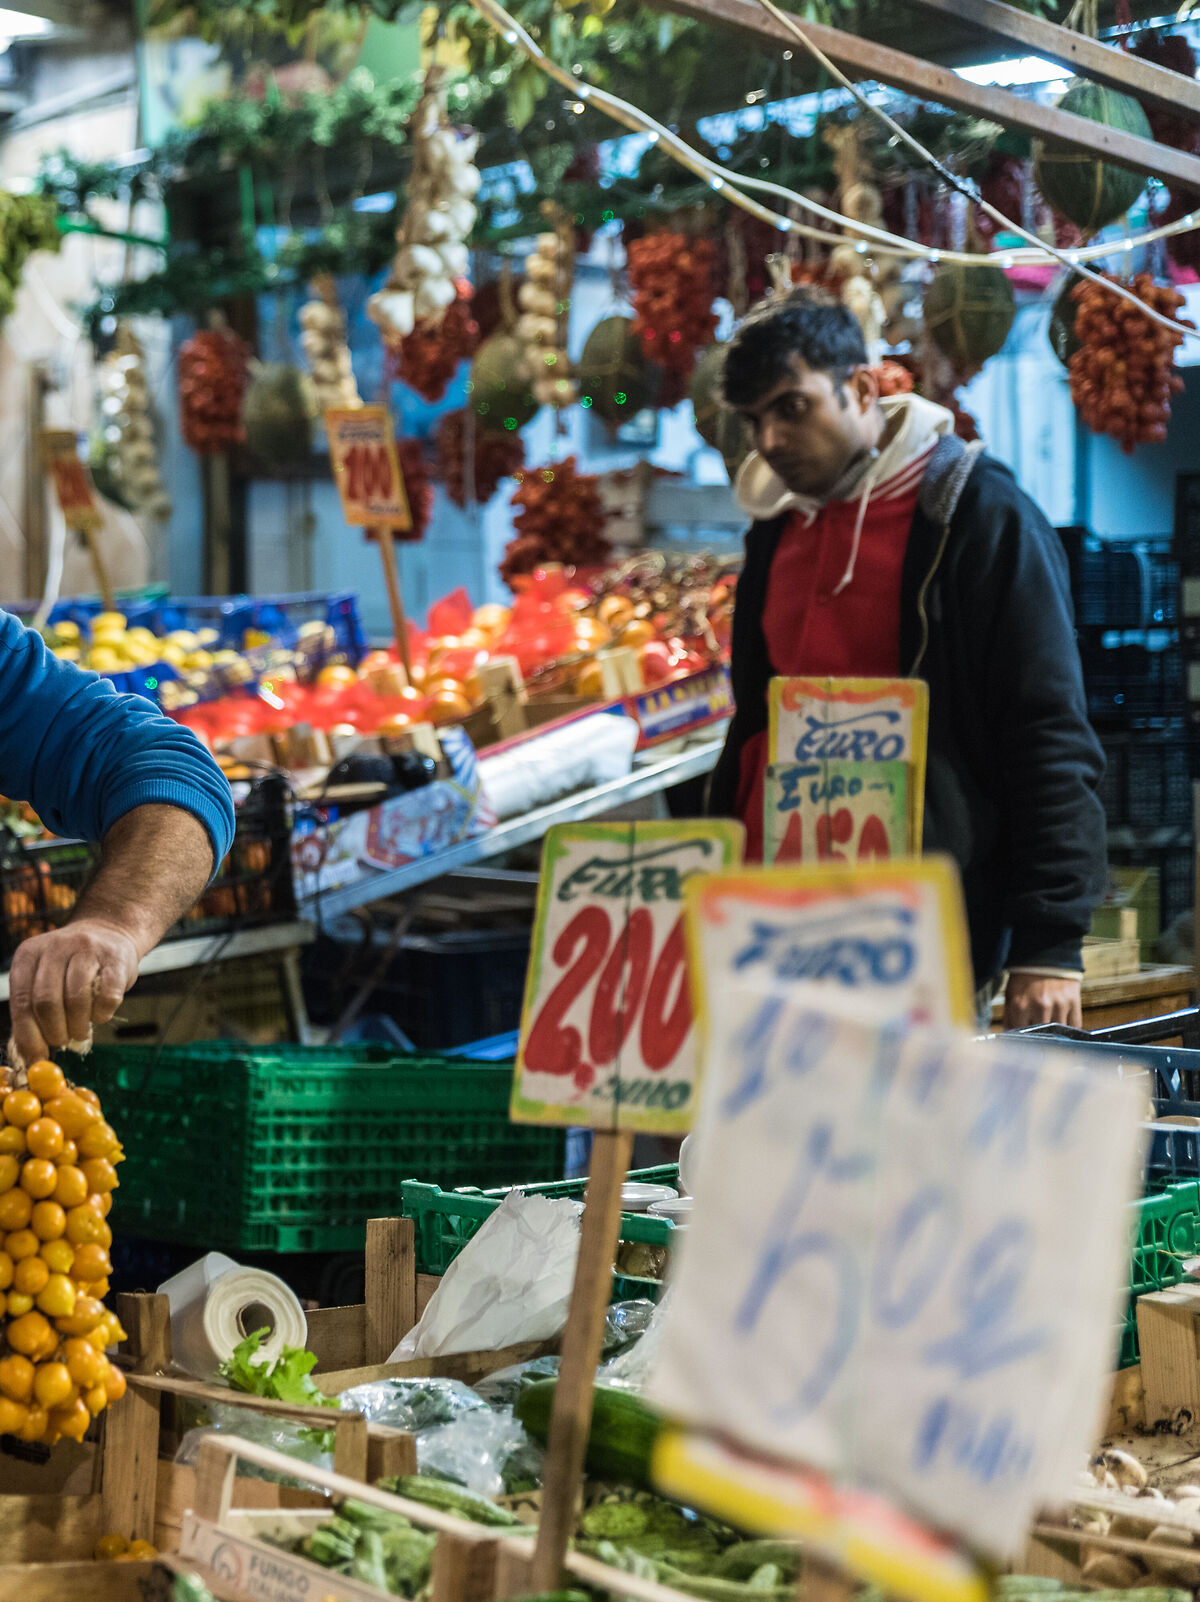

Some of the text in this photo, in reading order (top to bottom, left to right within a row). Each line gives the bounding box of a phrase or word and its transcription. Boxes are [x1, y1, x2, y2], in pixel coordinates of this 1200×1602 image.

[795, 710, 906, 762] EURO
[557, 838, 712, 902] EUR
[250, 1554, 311, 1594] FUNGO
